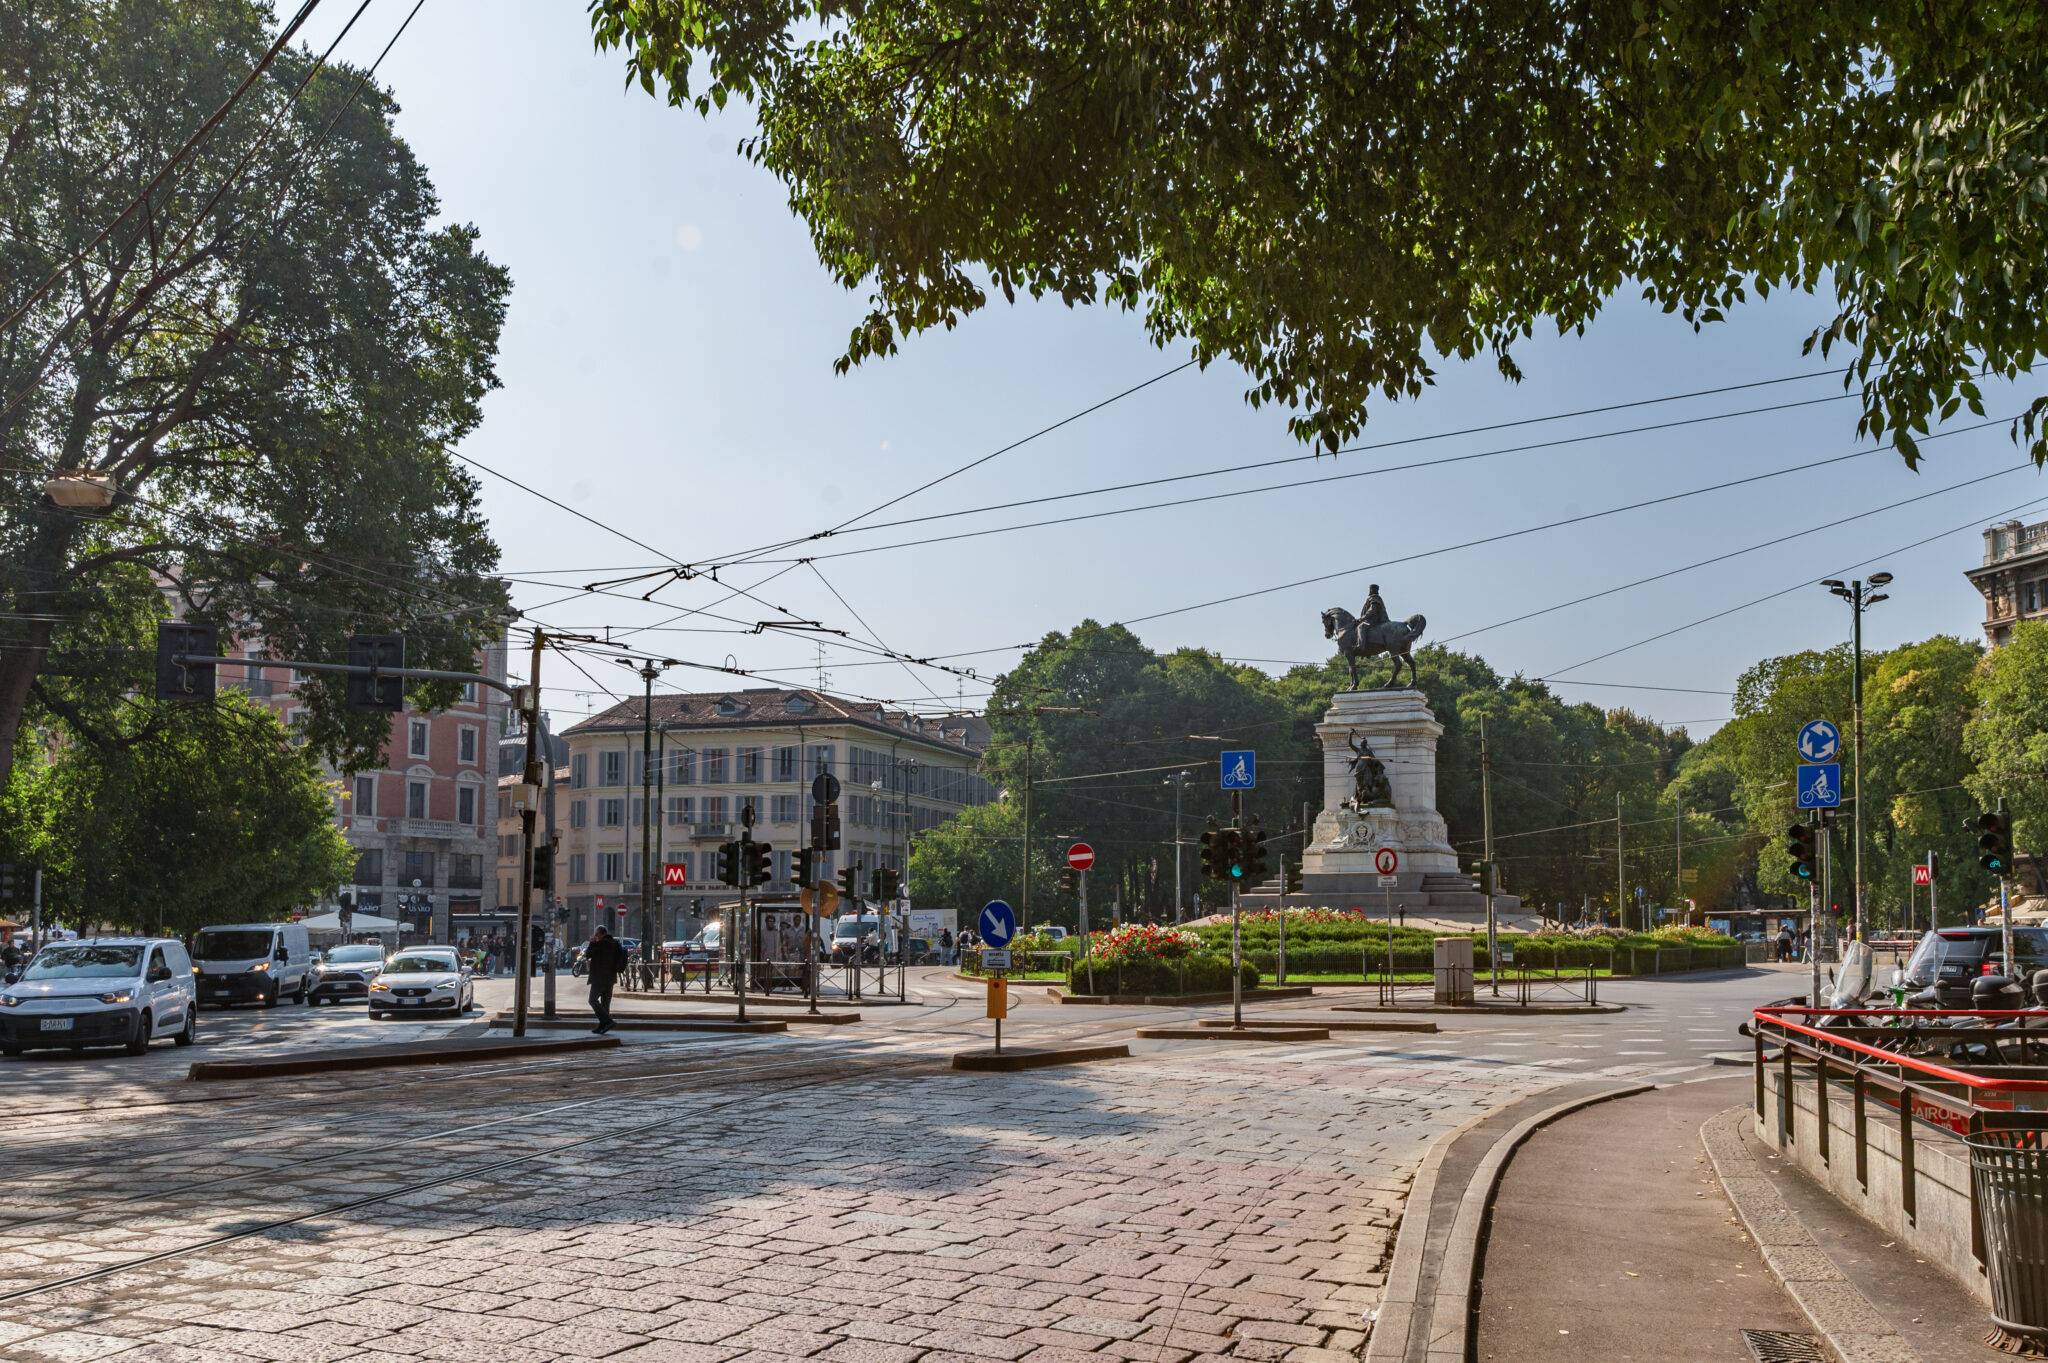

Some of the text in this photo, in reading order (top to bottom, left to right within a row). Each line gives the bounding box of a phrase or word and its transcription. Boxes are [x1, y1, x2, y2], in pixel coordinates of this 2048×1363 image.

[666, 868, 685, 882] M
[1916, 869, 1929, 882] M
[1911, 1106, 1961, 1120] AIROL
